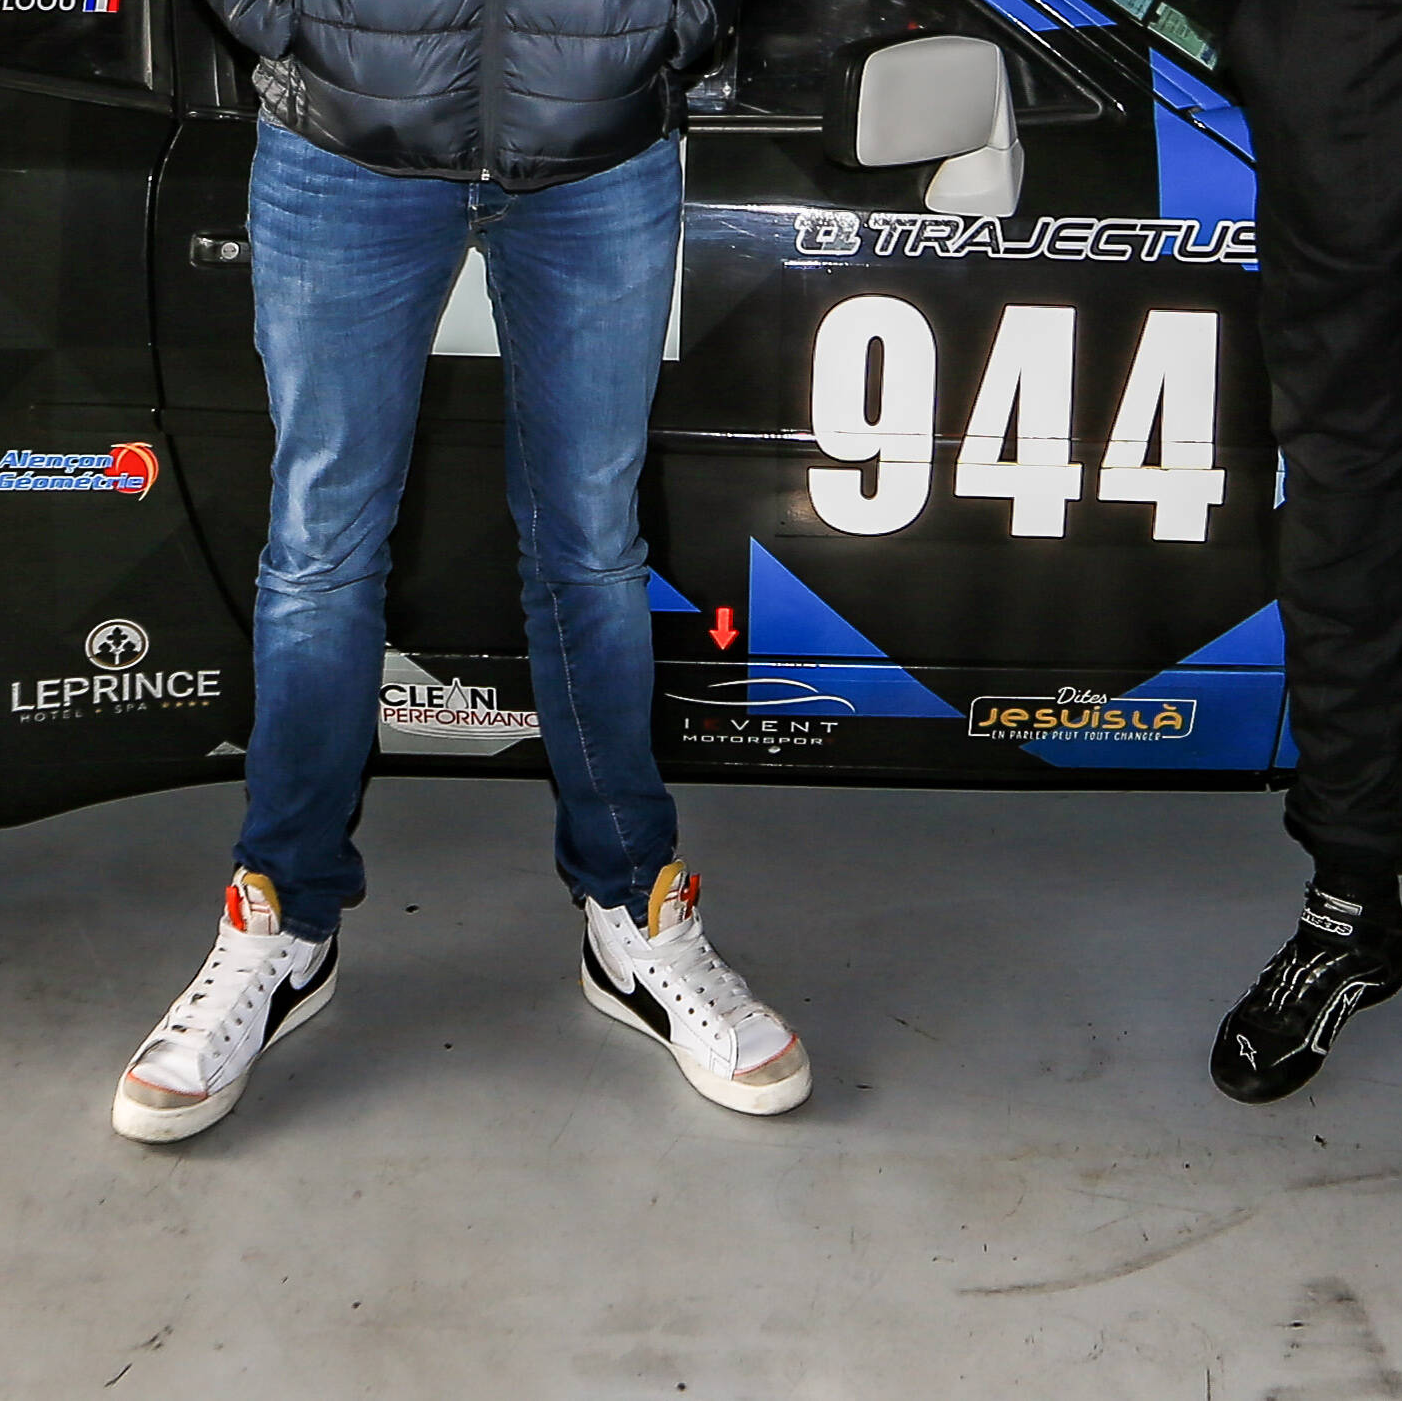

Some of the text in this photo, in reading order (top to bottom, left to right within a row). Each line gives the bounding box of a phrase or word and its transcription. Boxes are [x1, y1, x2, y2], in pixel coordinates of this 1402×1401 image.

[867, 211, 1258, 263] TRAJECTUS
[807, 295, 1225, 543] 944
[11, 669, 221, 713] LEPRINCE
[379, 678, 496, 710] CLEAN
[1056, 686, 1108, 705] Dites
[19, 701, 149, 724] HOTEL SPA
[383, 708, 541, 729] PERFORMANC
[991, 730, 1162, 743] EN PARLER PEUT TOUT CHANGER
